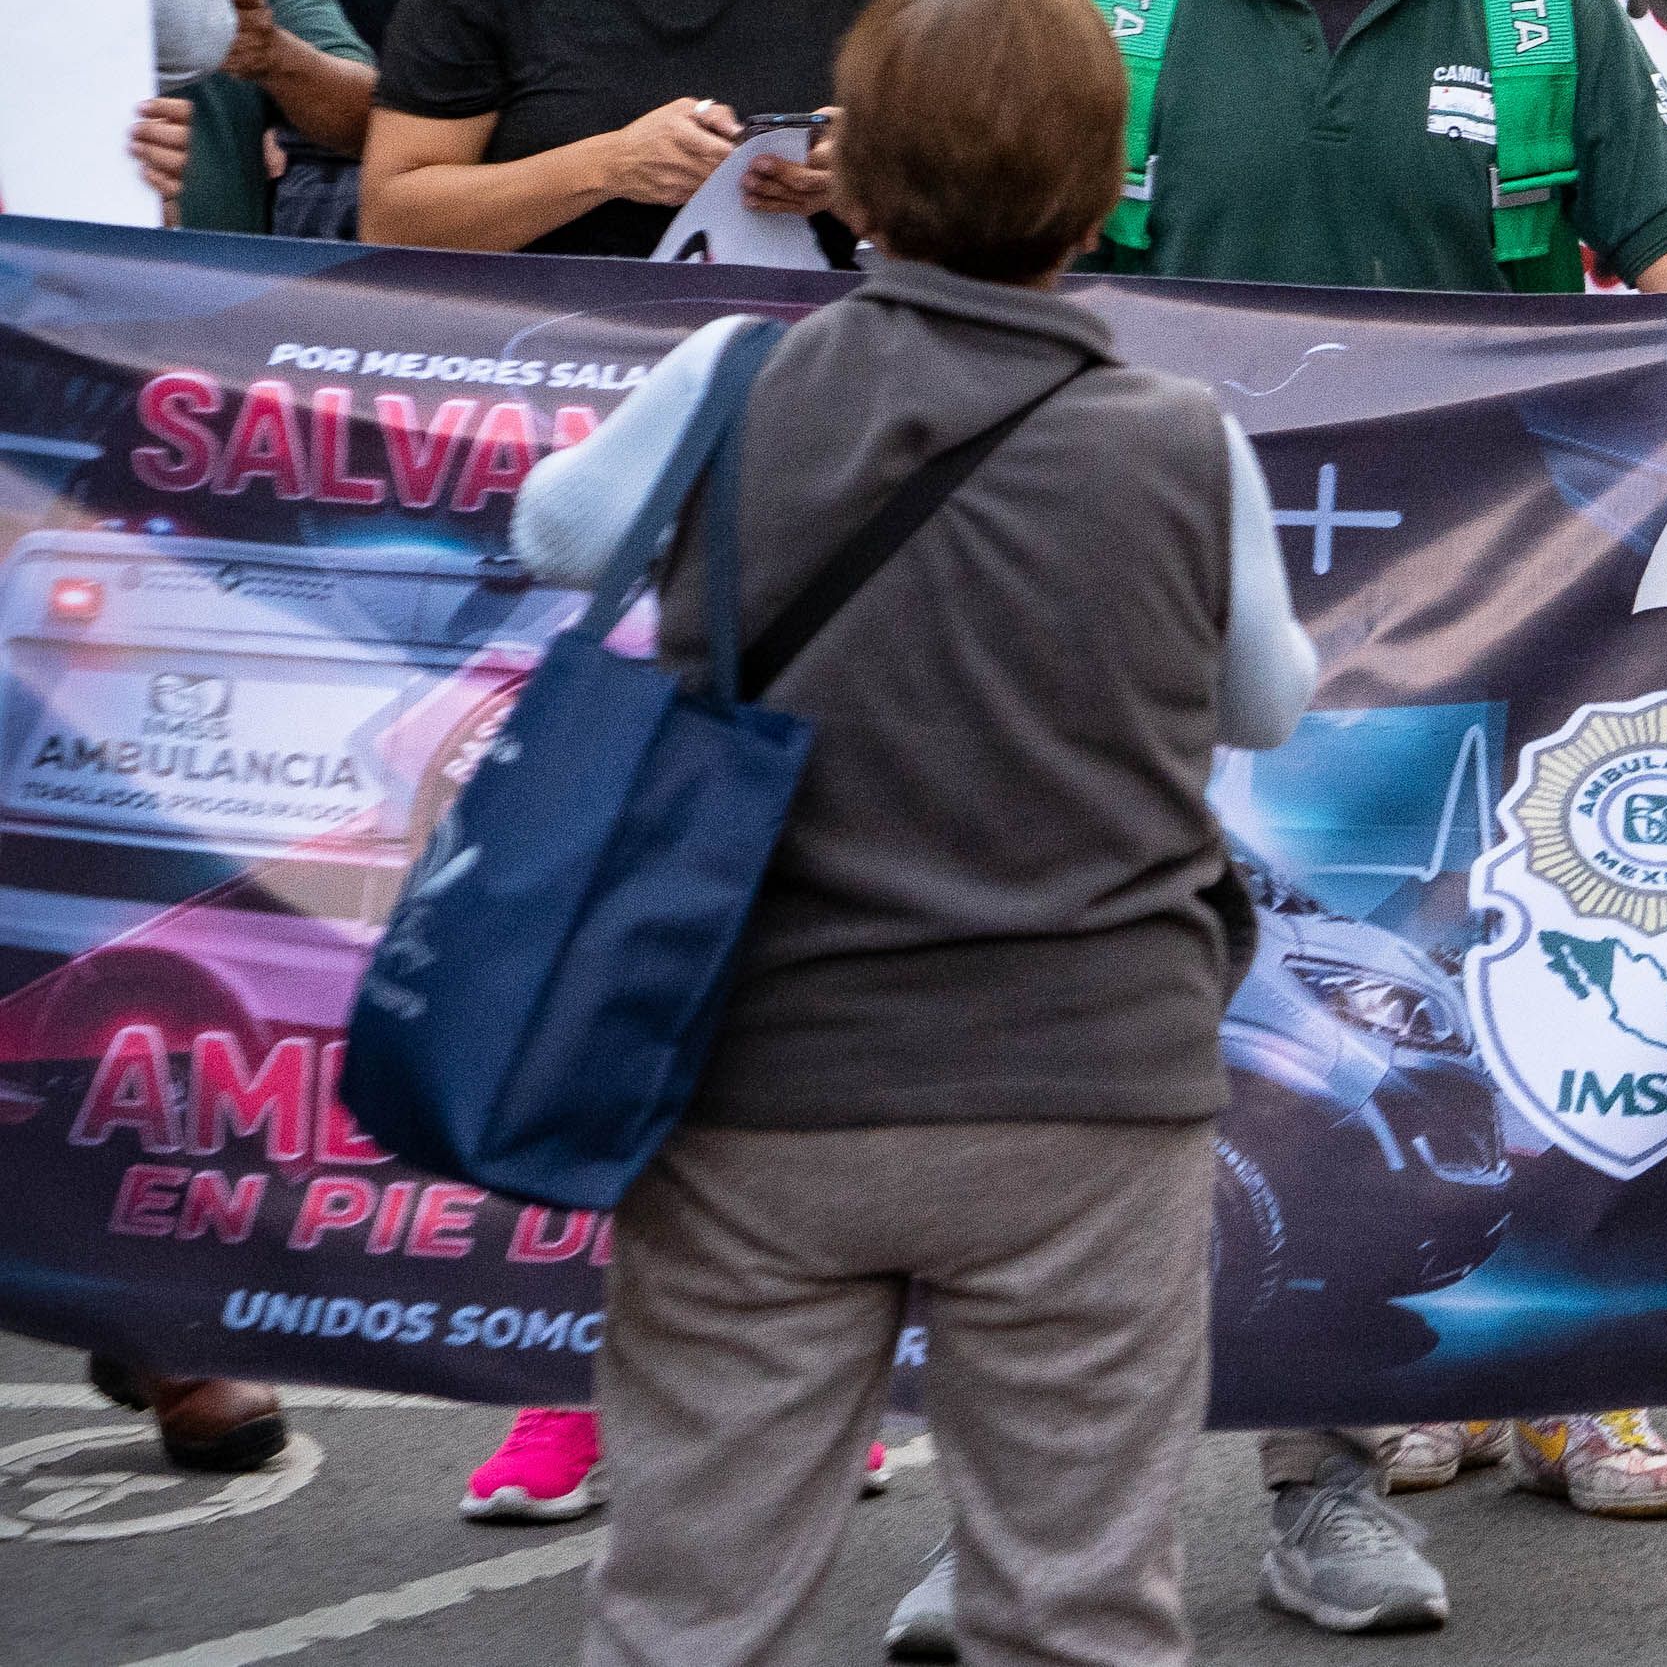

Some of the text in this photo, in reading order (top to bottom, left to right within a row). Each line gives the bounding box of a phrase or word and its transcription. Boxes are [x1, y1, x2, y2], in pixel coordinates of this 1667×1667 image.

[266, 343, 360, 374] POR
[360, 350, 544, 388] MEJORES
[33, 734, 367, 792] AMBULANCIA
[109, 1163, 270, 1243] EN
[285, 1175, 486, 1259] PIE
[222, 1287, 441, 1343] UNIDOS
